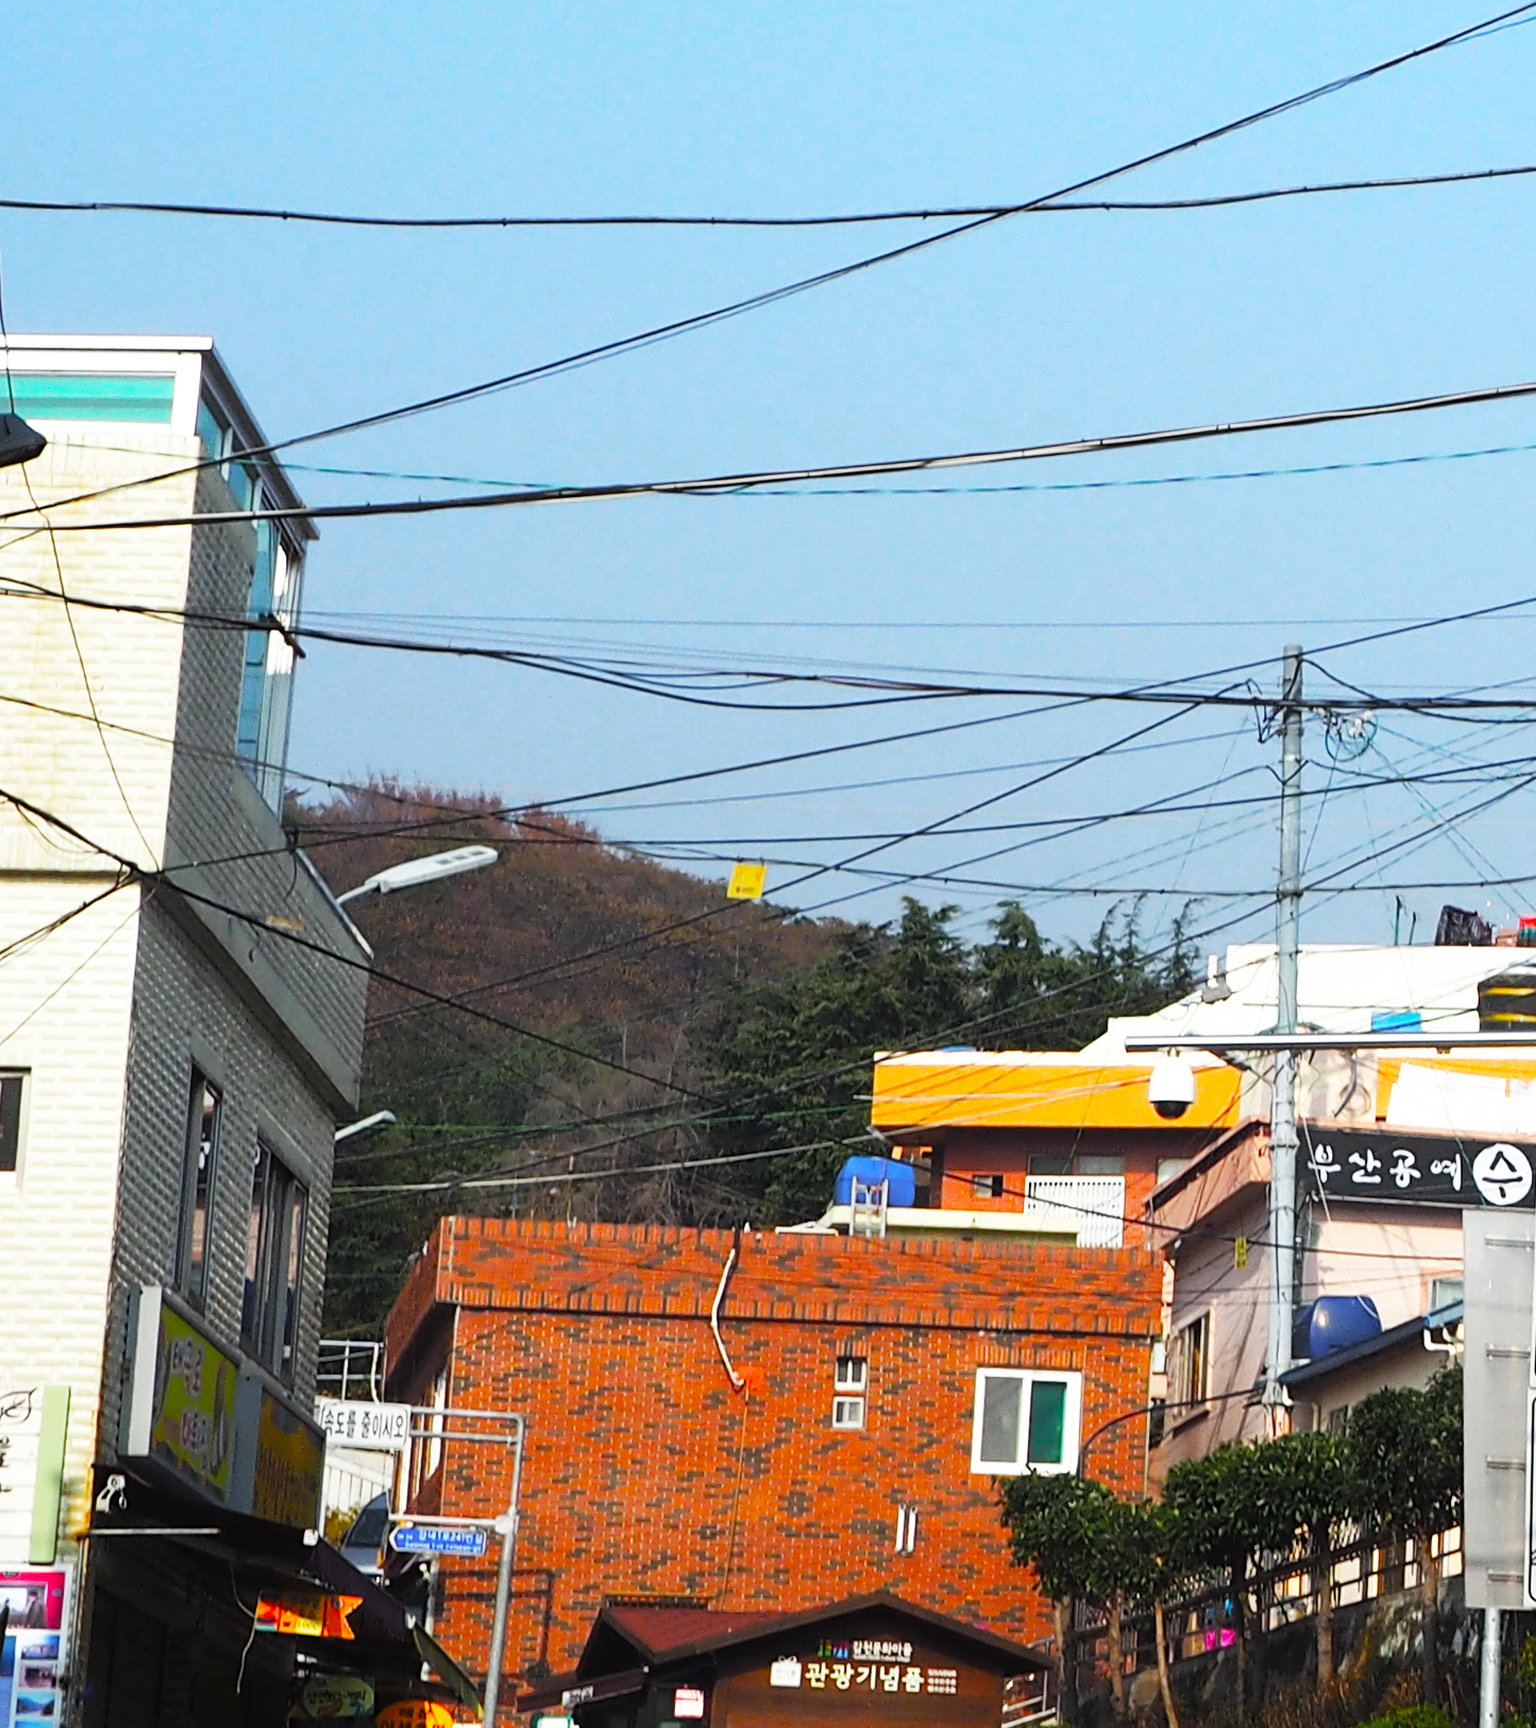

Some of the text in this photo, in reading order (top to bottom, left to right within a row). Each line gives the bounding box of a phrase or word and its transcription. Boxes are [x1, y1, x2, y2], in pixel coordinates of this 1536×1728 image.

[1308, 1143, 1524, 1199] 부산공예 수
[324, 1409, 404, 1439] 속도를 줄이시오
[805, 1662, 925, 1693] 관광기념품
